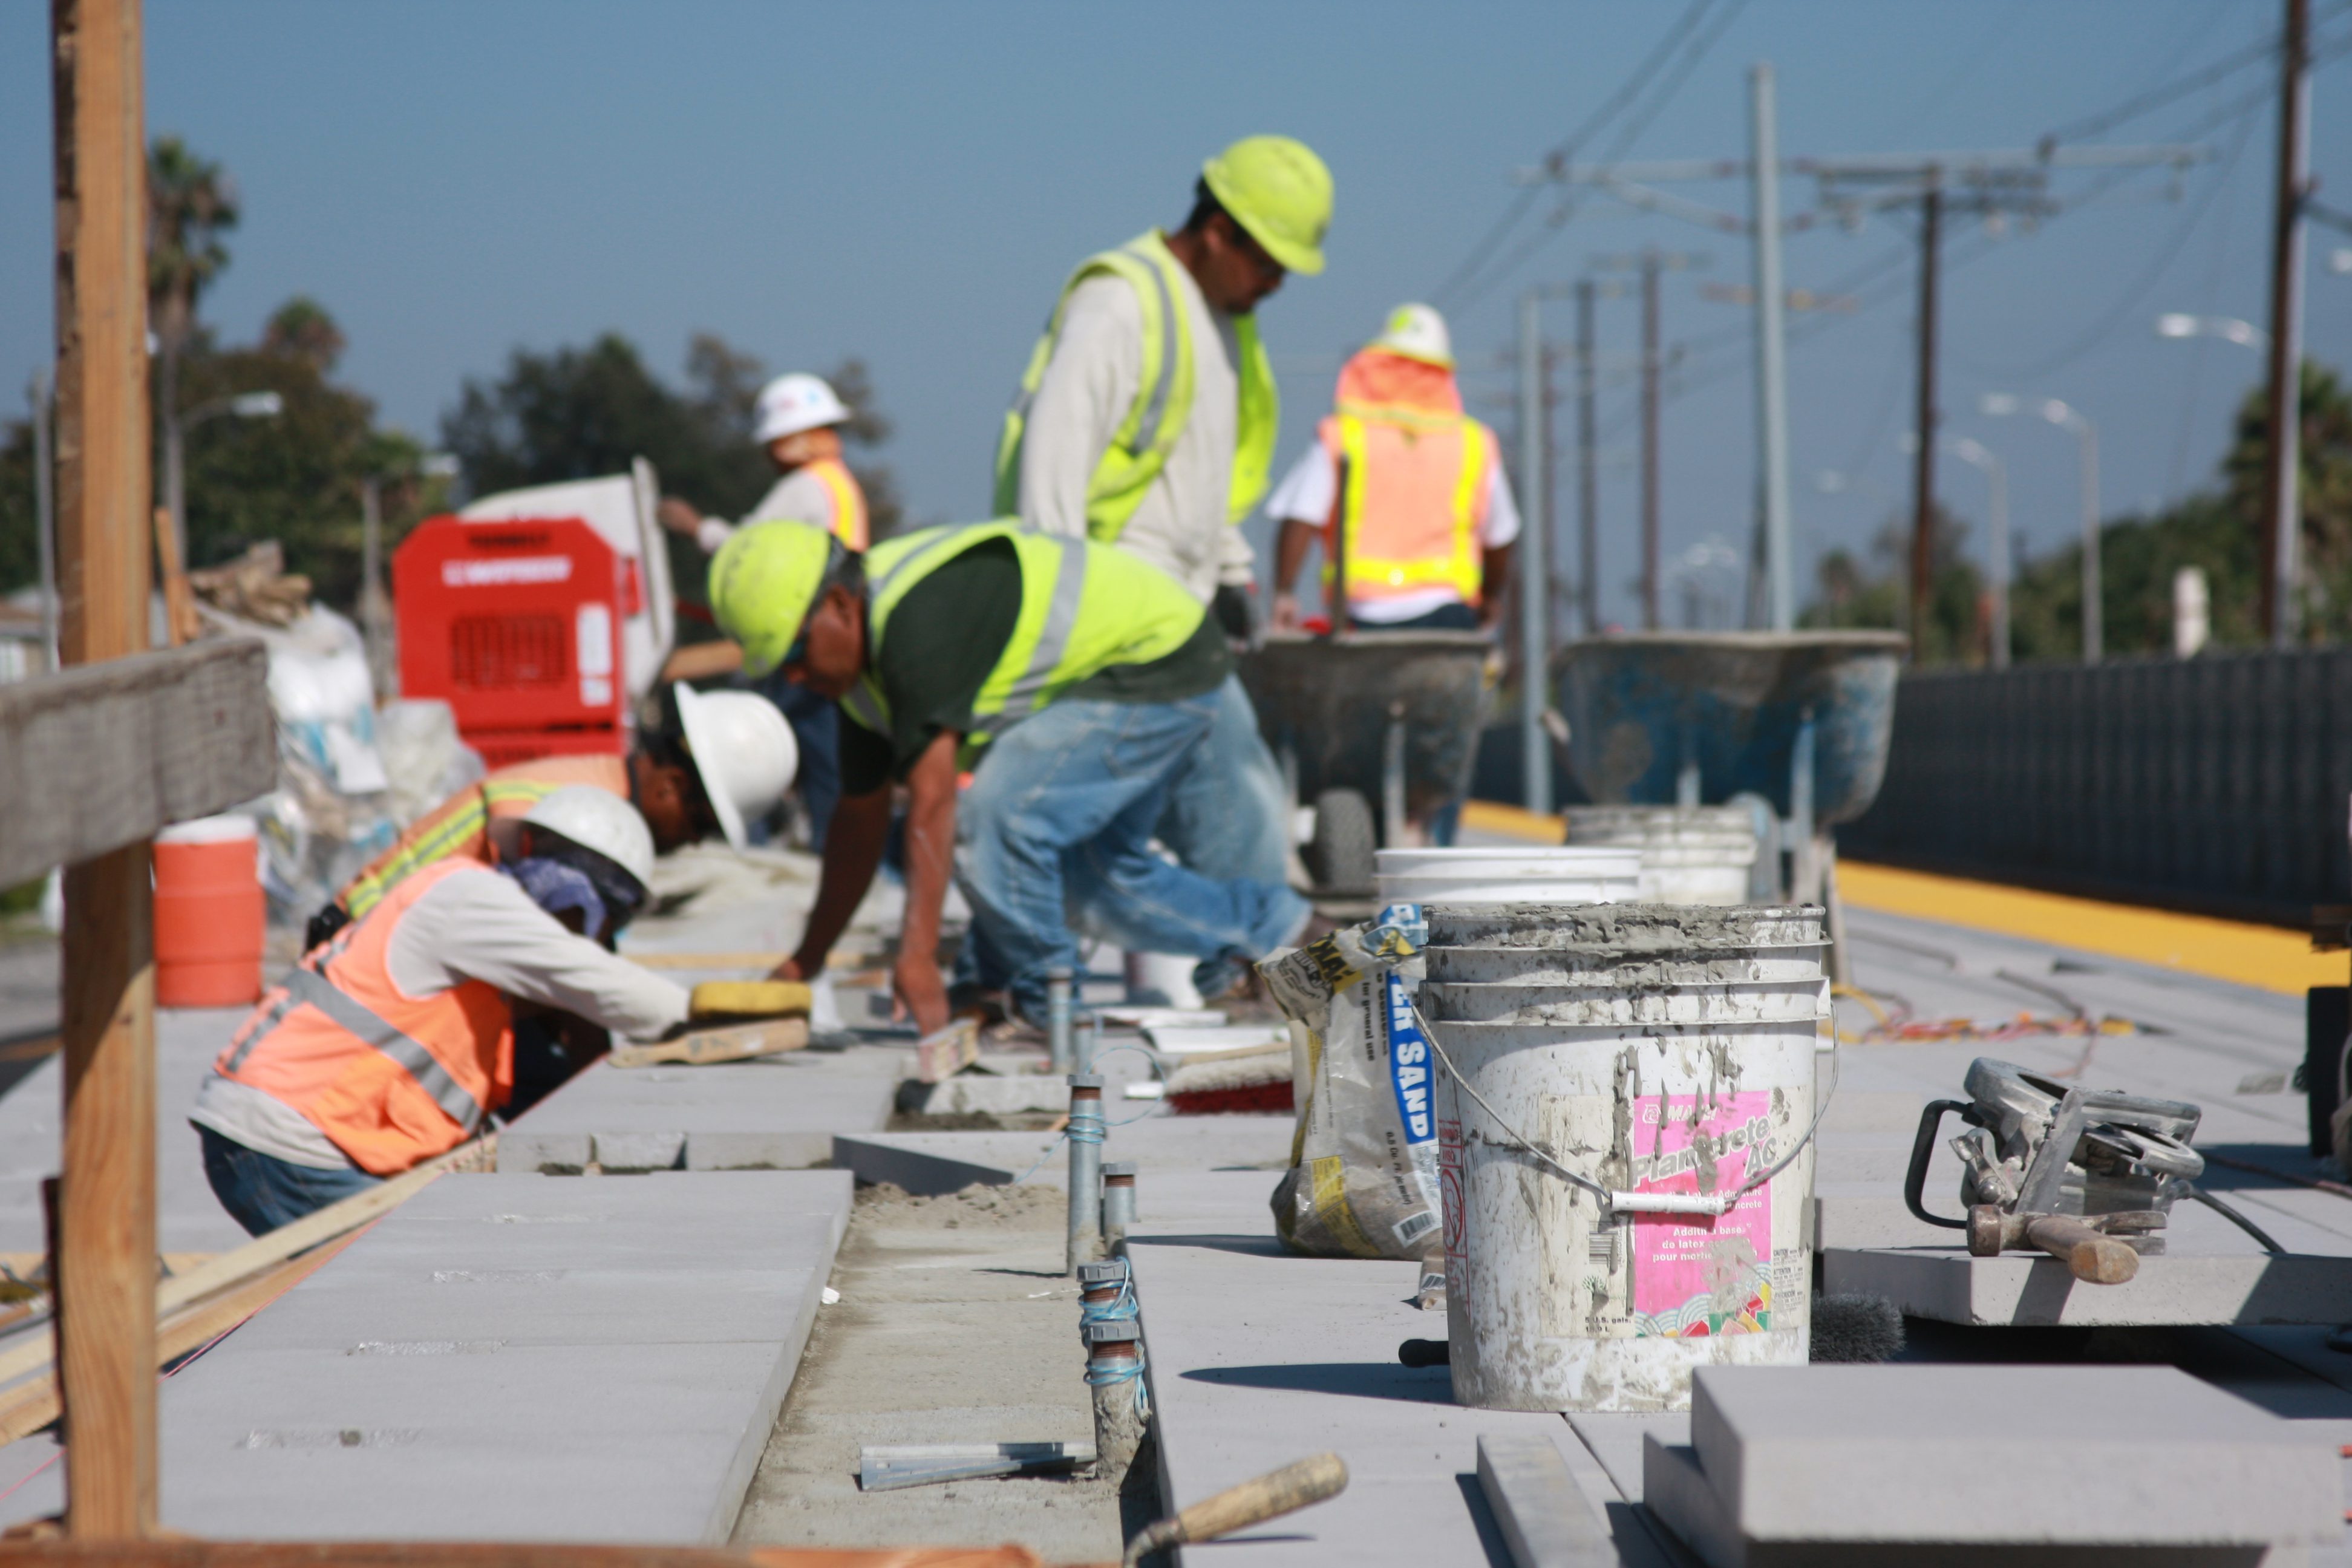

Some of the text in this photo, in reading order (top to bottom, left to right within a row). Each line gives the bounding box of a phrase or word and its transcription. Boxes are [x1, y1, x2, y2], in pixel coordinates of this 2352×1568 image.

[1362, 1001, 1374, 1040] general
[1365, 1042, 1375, 1061] use
[1397, 1041, 1428, 1138] SAND
[1667, 1105, 1717, 1122] MAEI
[1633, 1116, 1771, 1187] Plancrete
[1744, 1137, 1777, 1178] AC
[1718, 1189, 1763, 1198] Admture
[1662, 1240, 1675, 1249] de
[1679, 1240, 1705, 1249] latex
[1653, 1252, 1713, 1263] pour mortie
